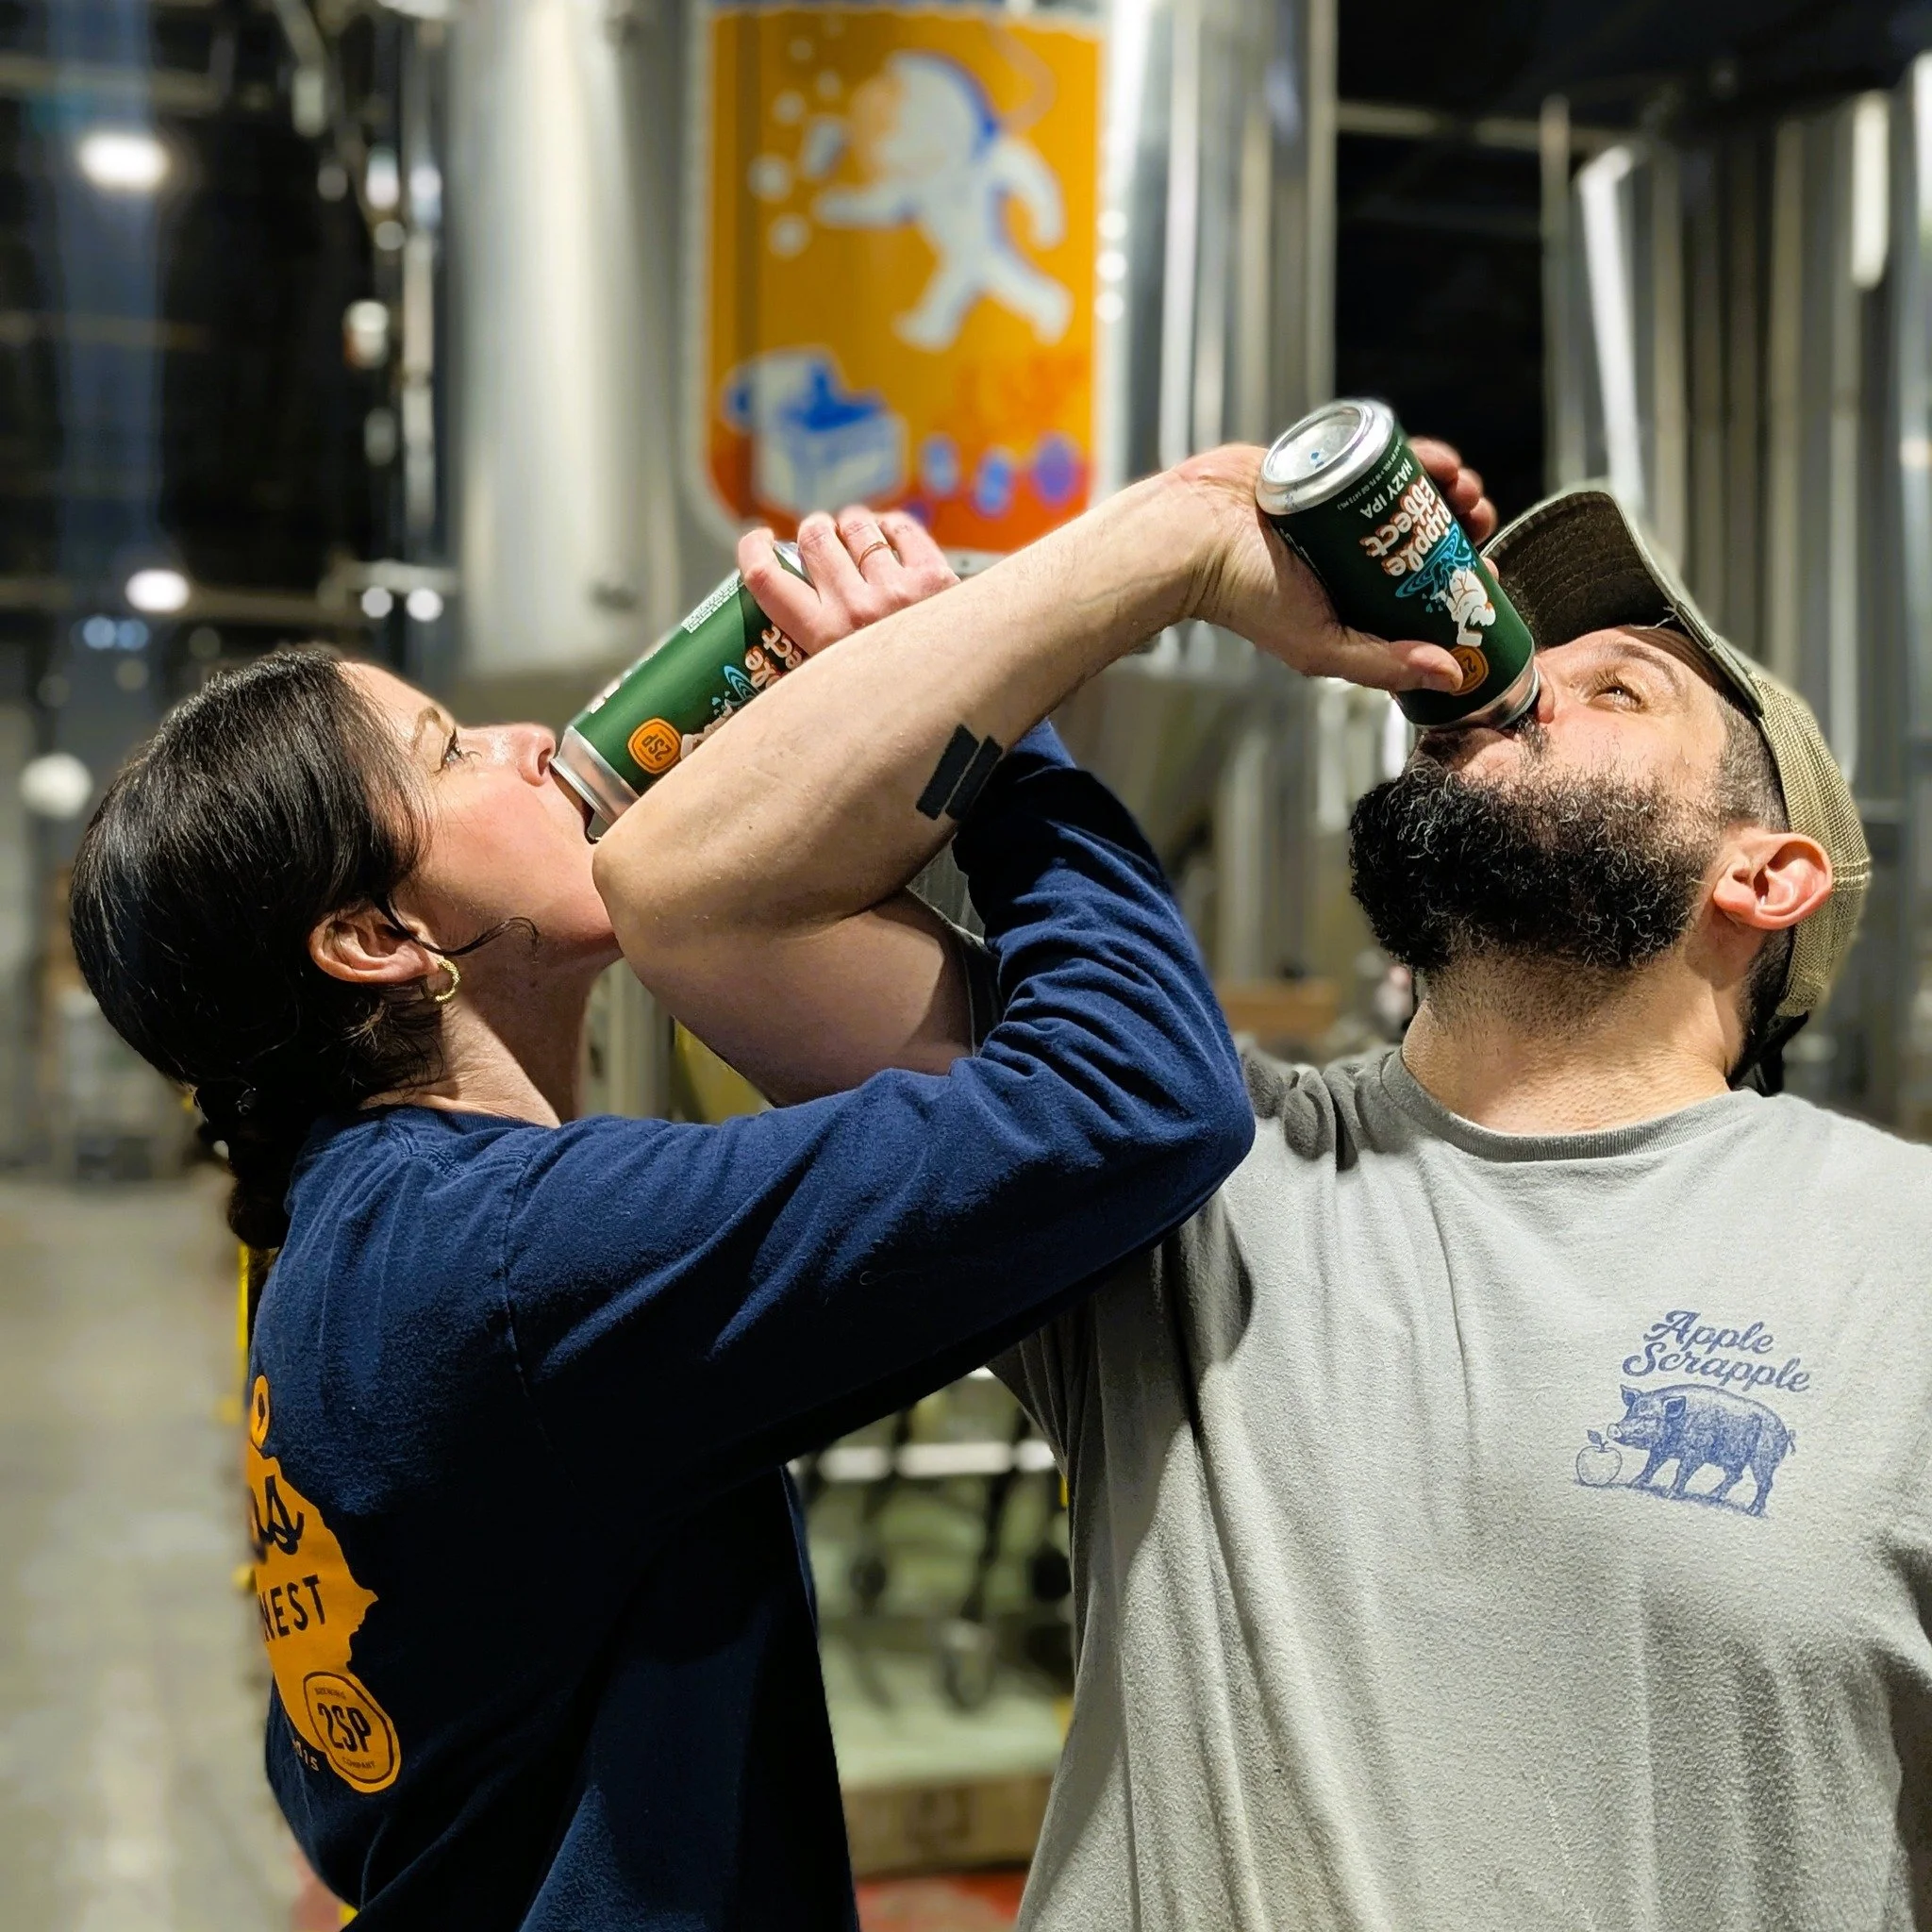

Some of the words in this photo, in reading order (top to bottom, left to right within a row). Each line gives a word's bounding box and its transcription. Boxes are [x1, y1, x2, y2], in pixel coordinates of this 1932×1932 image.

[1386, 458, 1414, 501] HAZY
[1359, 492, 1388, 519] IPA
[1362, 475, 1436, 558] Effect
[1384, 496, 1453, 576] Ripple
[1642, 1309, 1774, 1355] Apple
[1622, 1341, 1810, 1393] Scrapple
[317, 1702, 372, 1753] 2SP
